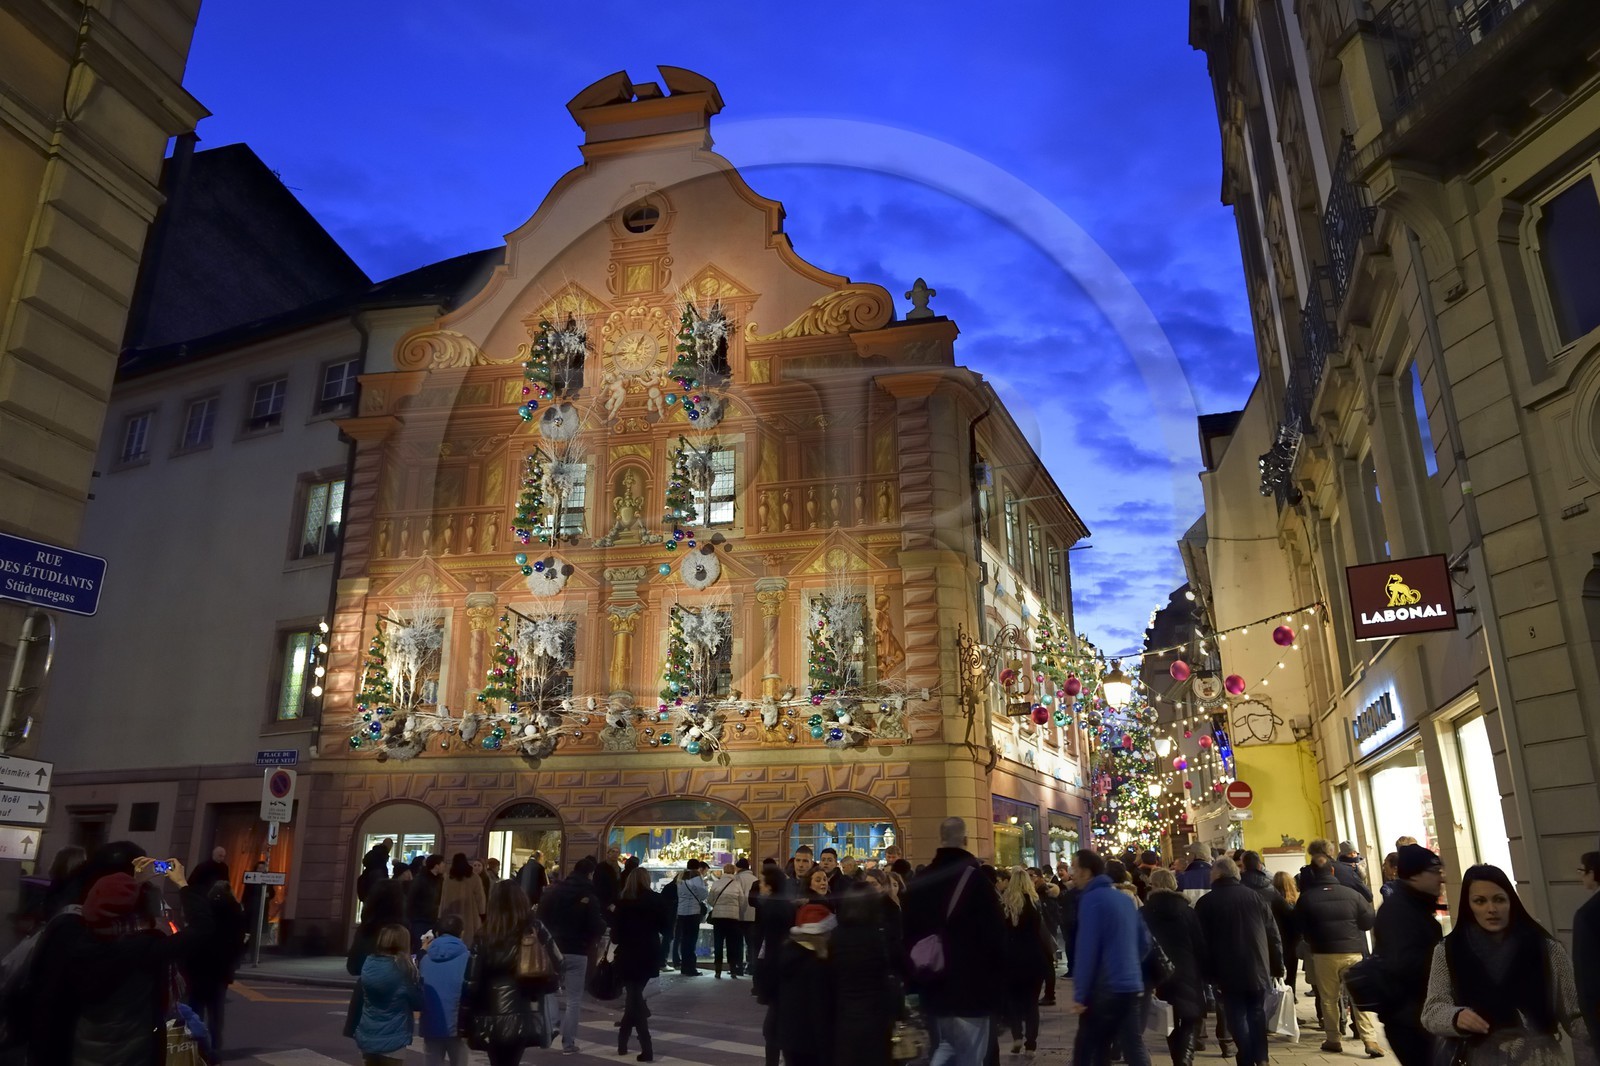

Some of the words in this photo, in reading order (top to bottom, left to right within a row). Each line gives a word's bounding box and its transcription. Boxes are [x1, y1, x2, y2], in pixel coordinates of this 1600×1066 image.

[36, 551, 63, 567] RUE
[22, 562, 94, 591] ÉTUDIANTS
[5, 578, 75, 603] Stüdentegass
[1361, 603, 1447, 625] LABONAL
[1352, 692, 1396, 744] LABONAL
[1, 794, 21, 803] Noël
